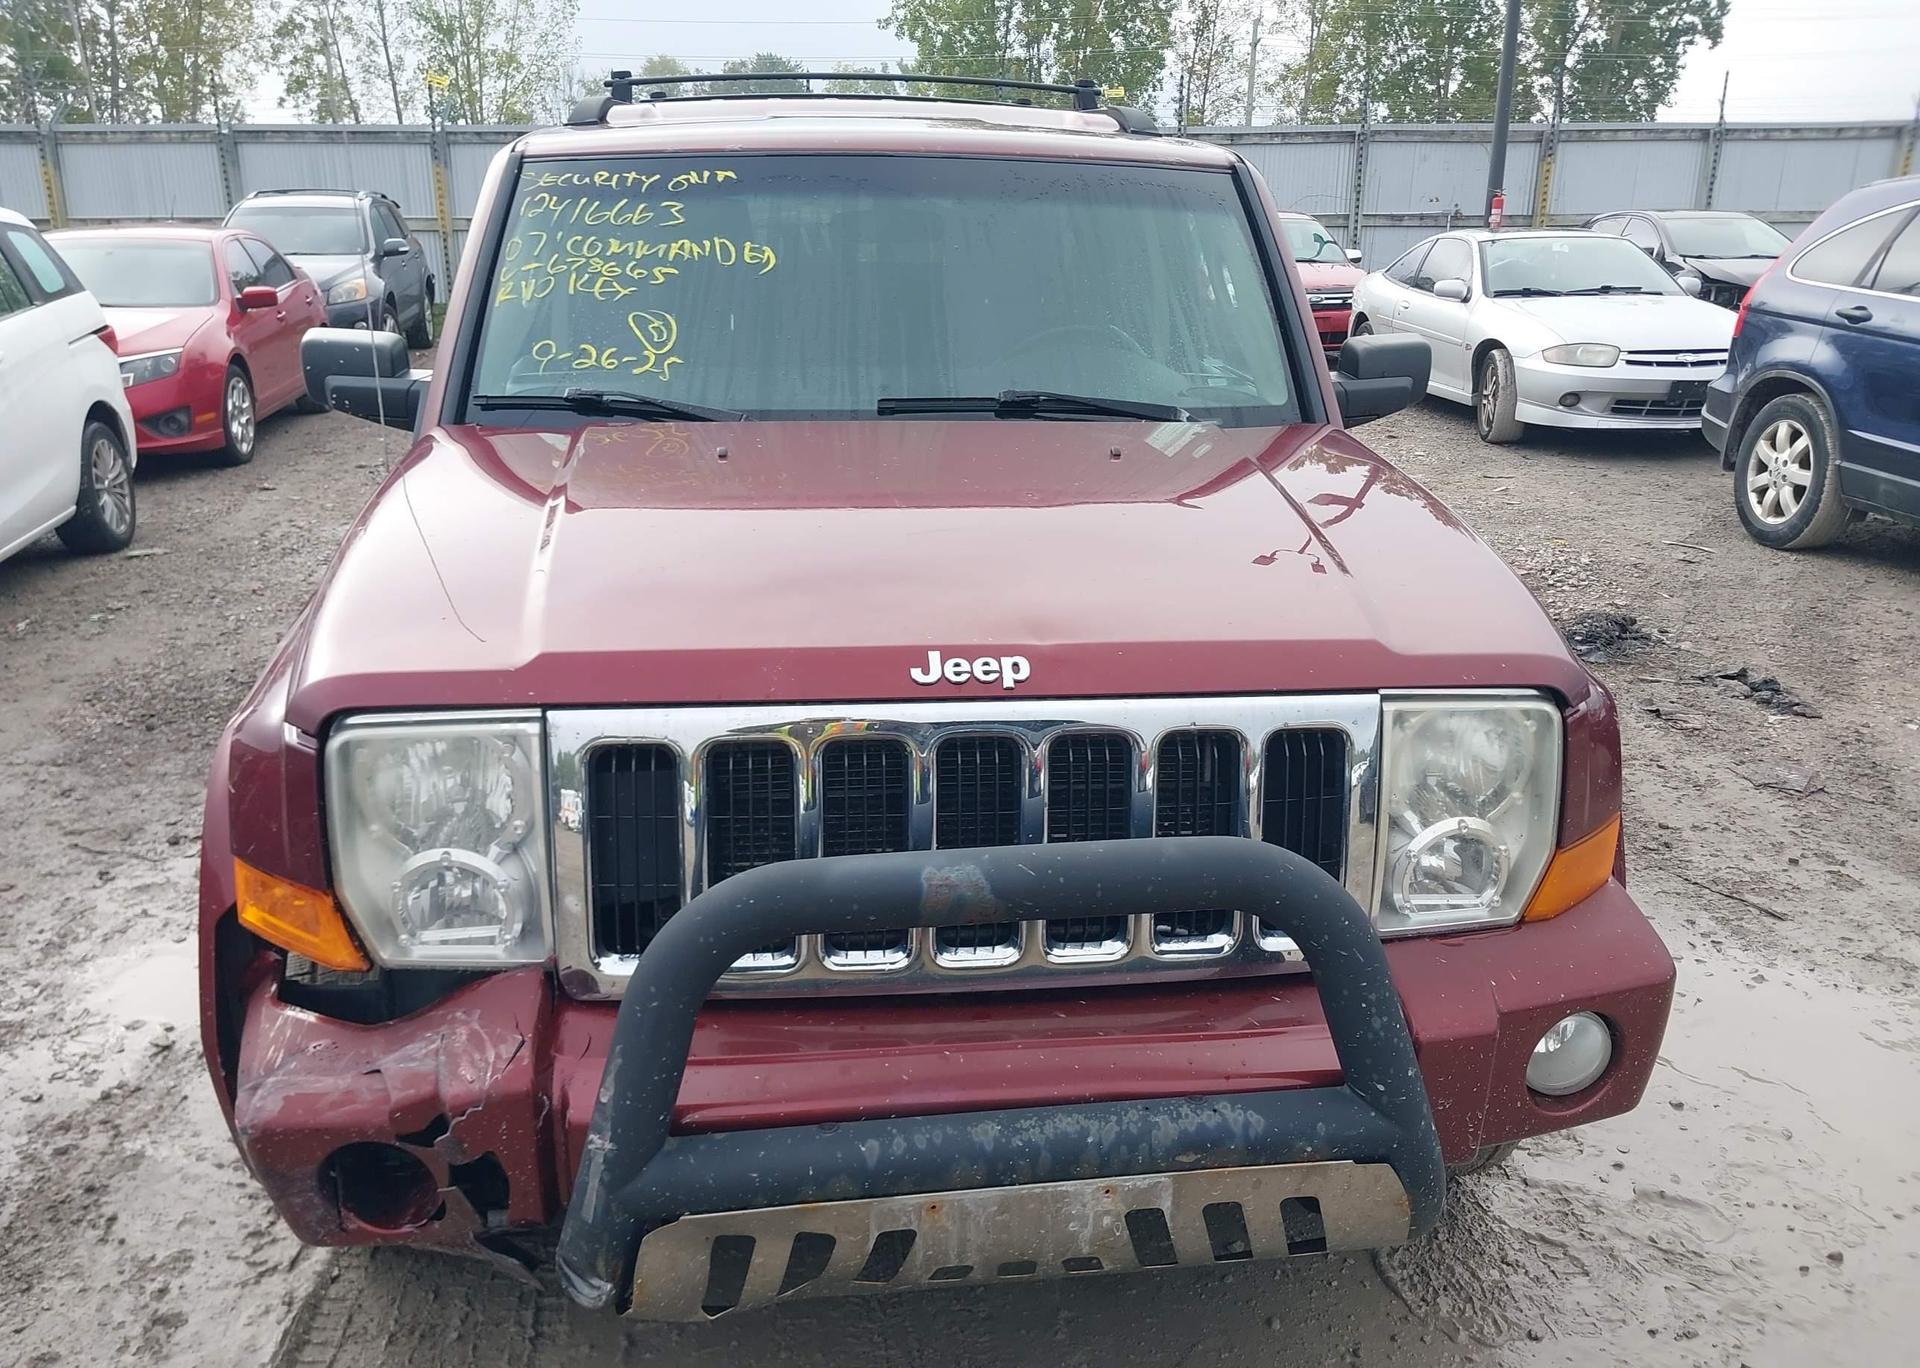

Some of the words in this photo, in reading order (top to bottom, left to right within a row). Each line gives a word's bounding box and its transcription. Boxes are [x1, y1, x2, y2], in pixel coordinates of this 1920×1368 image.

[520, 170, 661, 192] SECURITY
[519, 193, 686, 226] 12416663
[568, 272, 638, 302] KEY
[532, 340, 686, 382] 9-26-25
[909, 650, 1031, 690] Jeep
